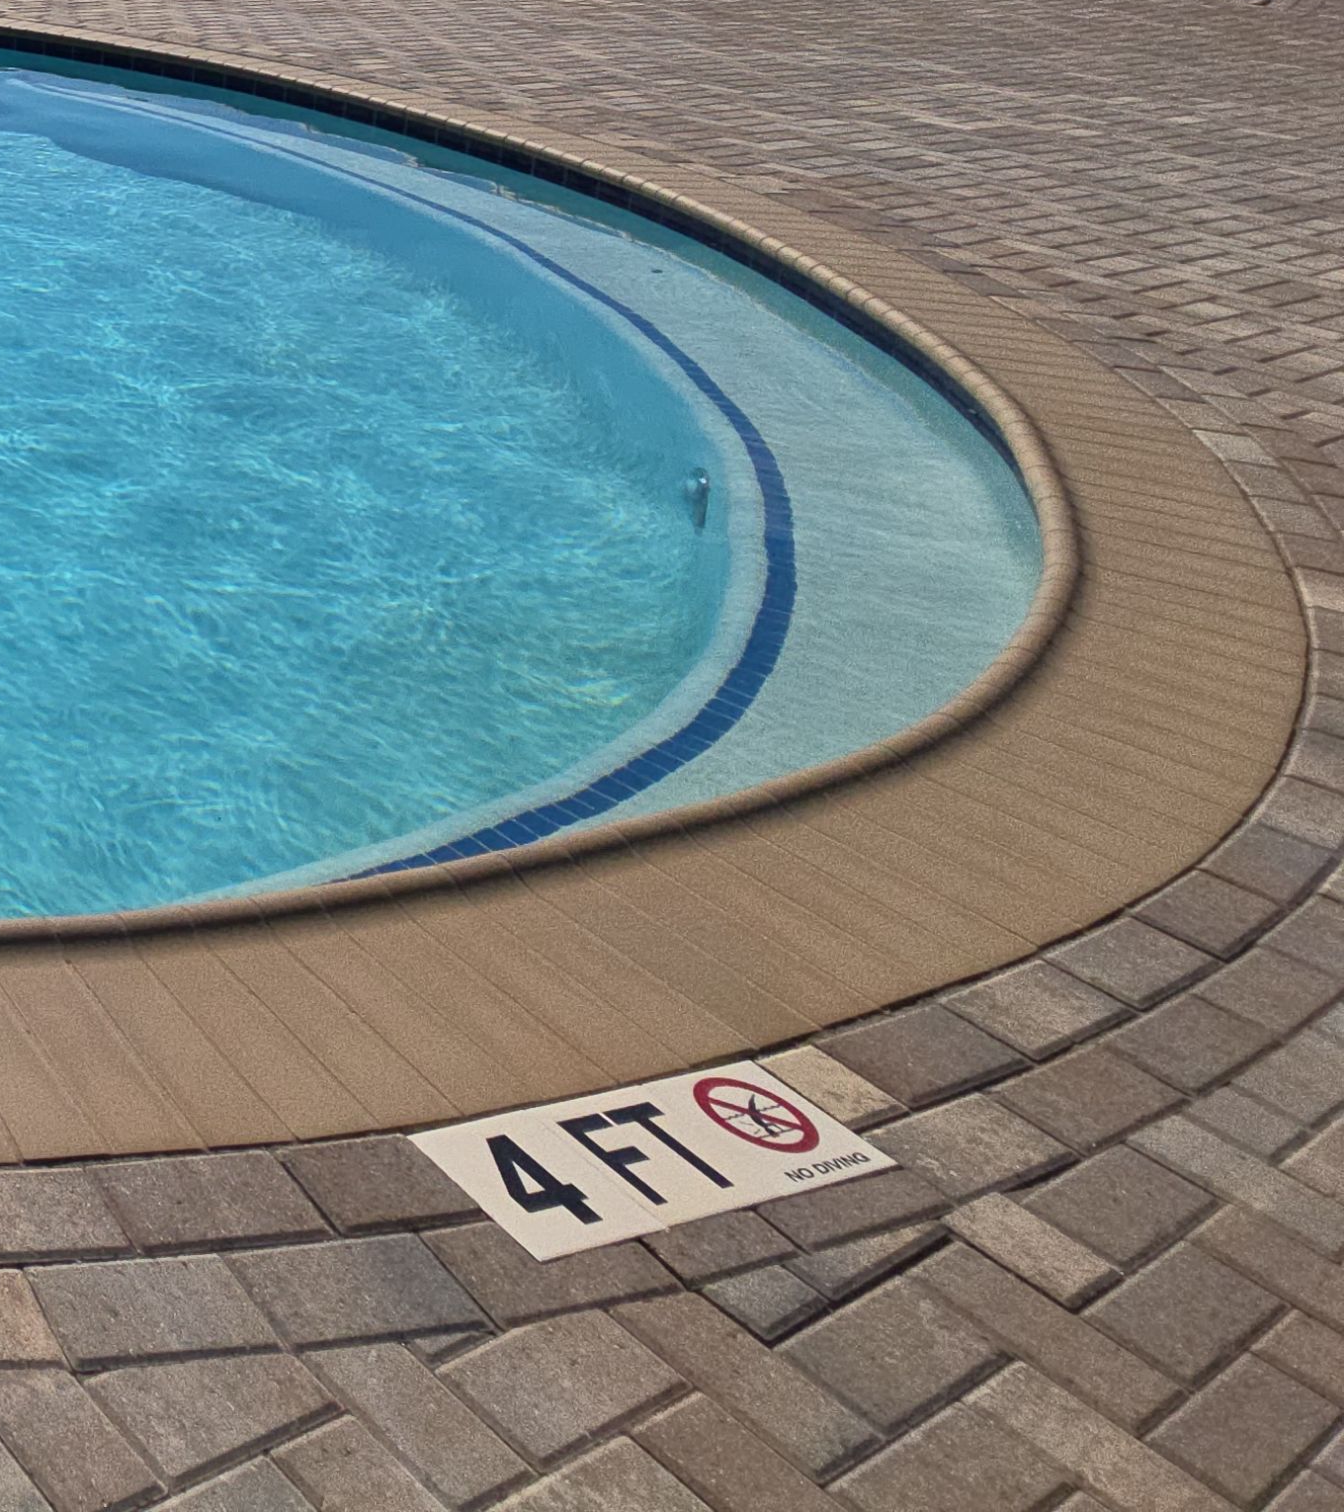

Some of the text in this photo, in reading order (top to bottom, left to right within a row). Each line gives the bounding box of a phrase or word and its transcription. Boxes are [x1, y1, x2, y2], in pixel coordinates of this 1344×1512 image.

[485, 1101, 735, 1225] 4 FT
[783, 1152, 871, 1183] NO DIVING
